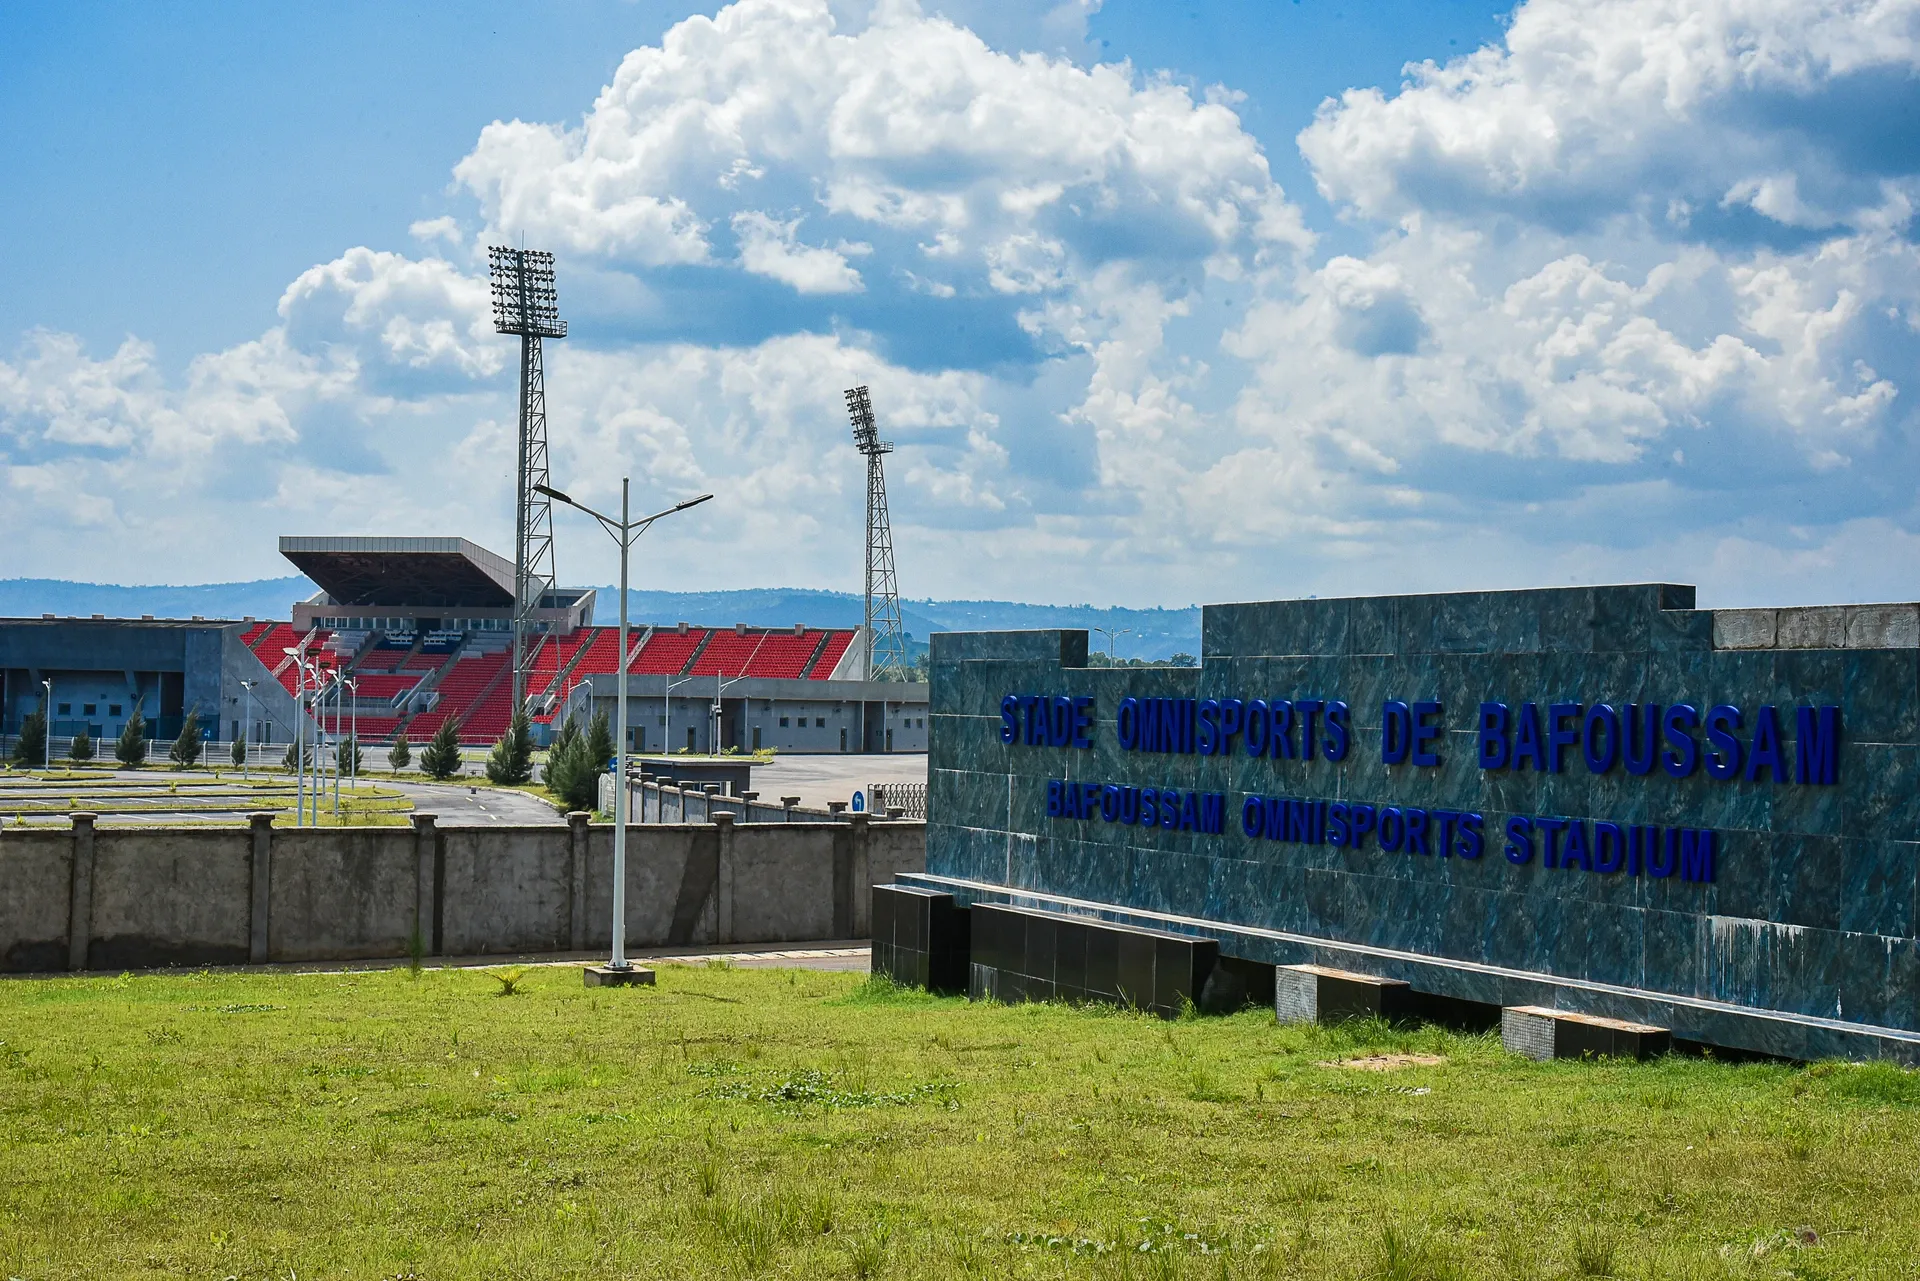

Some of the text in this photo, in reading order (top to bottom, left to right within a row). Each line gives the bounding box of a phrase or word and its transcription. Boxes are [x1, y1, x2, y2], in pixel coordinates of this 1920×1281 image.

[1000, 695, 1840, 785] STADE OMNISPORTS DE BAFOUSSAM
[1047, 780, 1717, 883] BAFOUSSAM OMNISPORTS STADIUM
